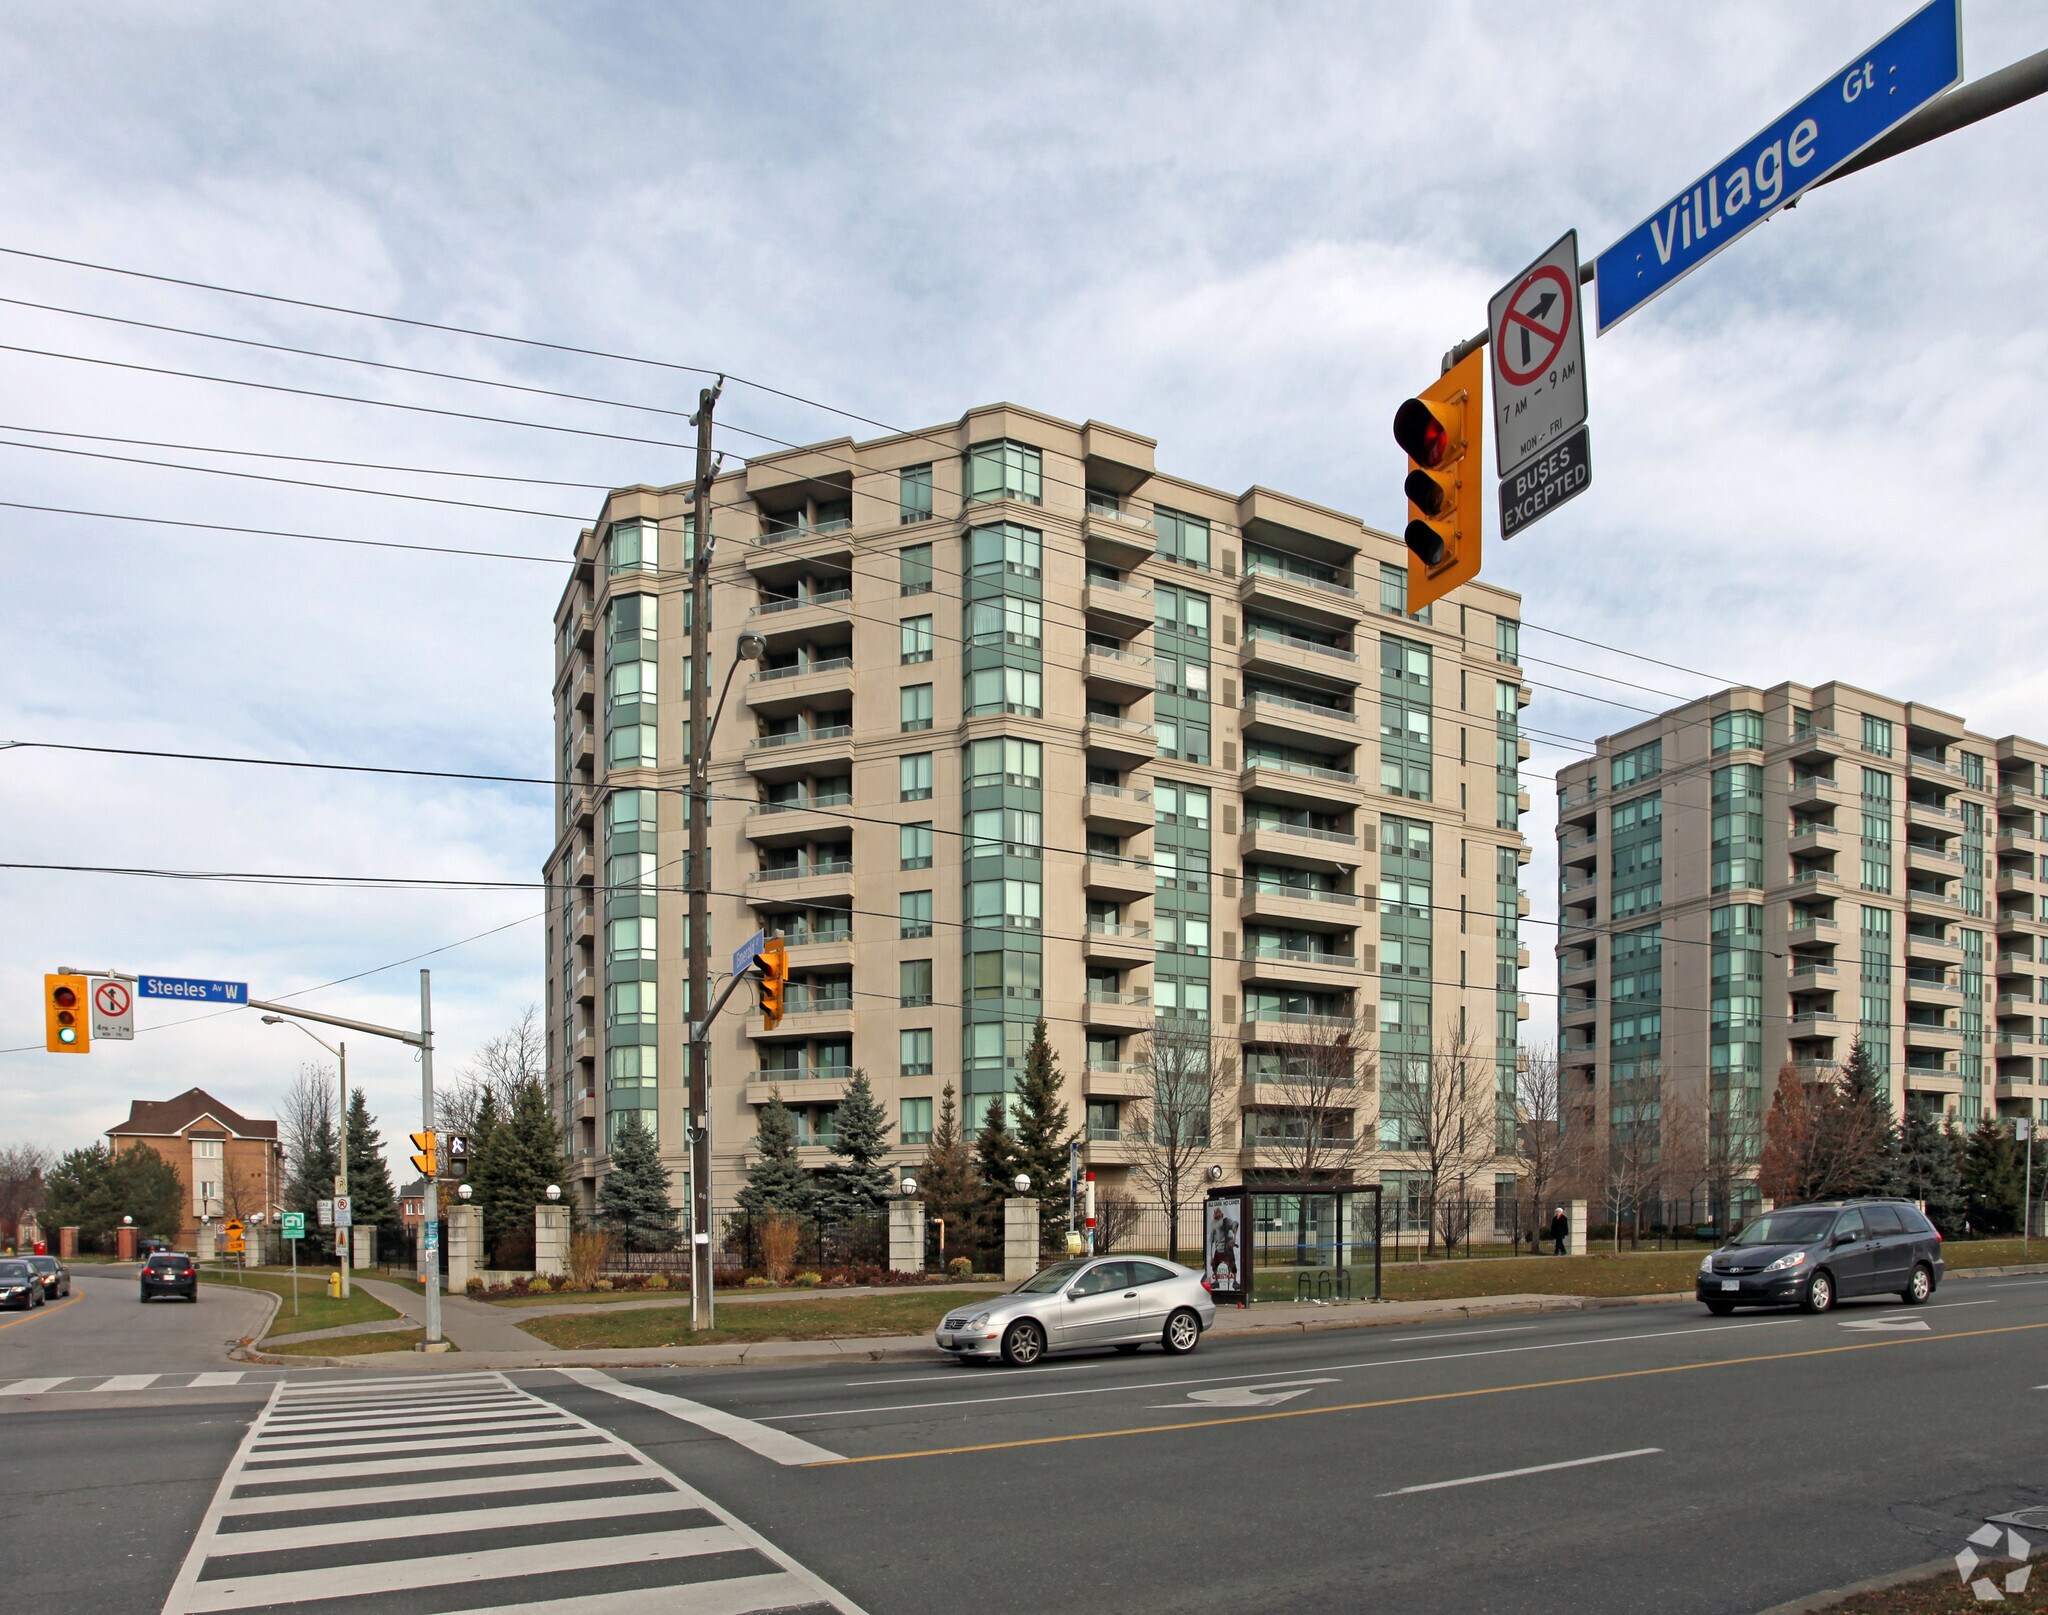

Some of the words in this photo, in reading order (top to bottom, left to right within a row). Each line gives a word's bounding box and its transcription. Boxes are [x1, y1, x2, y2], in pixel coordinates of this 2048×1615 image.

[1650, 118, 1818, 265] Village
[1842, 61, 1875, 103] Gt
[1503, 405, 1510, 424] 7
[1514, 397, 1527, 417] AM
[1550, 371, 1557, 389] 9
[1562, 361, 1575, 382] AM
[1521, 435, 1537, 456] MON
[1550, 417, 1562, 436] FRI
[1516, 447, 1570, 497] BUSES
[1505, 463, 1586, 530] EXCEPTED
[736, 940, 755, 968] Emerald
[148, 979, 207, 998] Steeles
[212, 984, 222, 992] Av
[225, 984, 238, 999] W
[698, 1192, 707, 1200] 68
